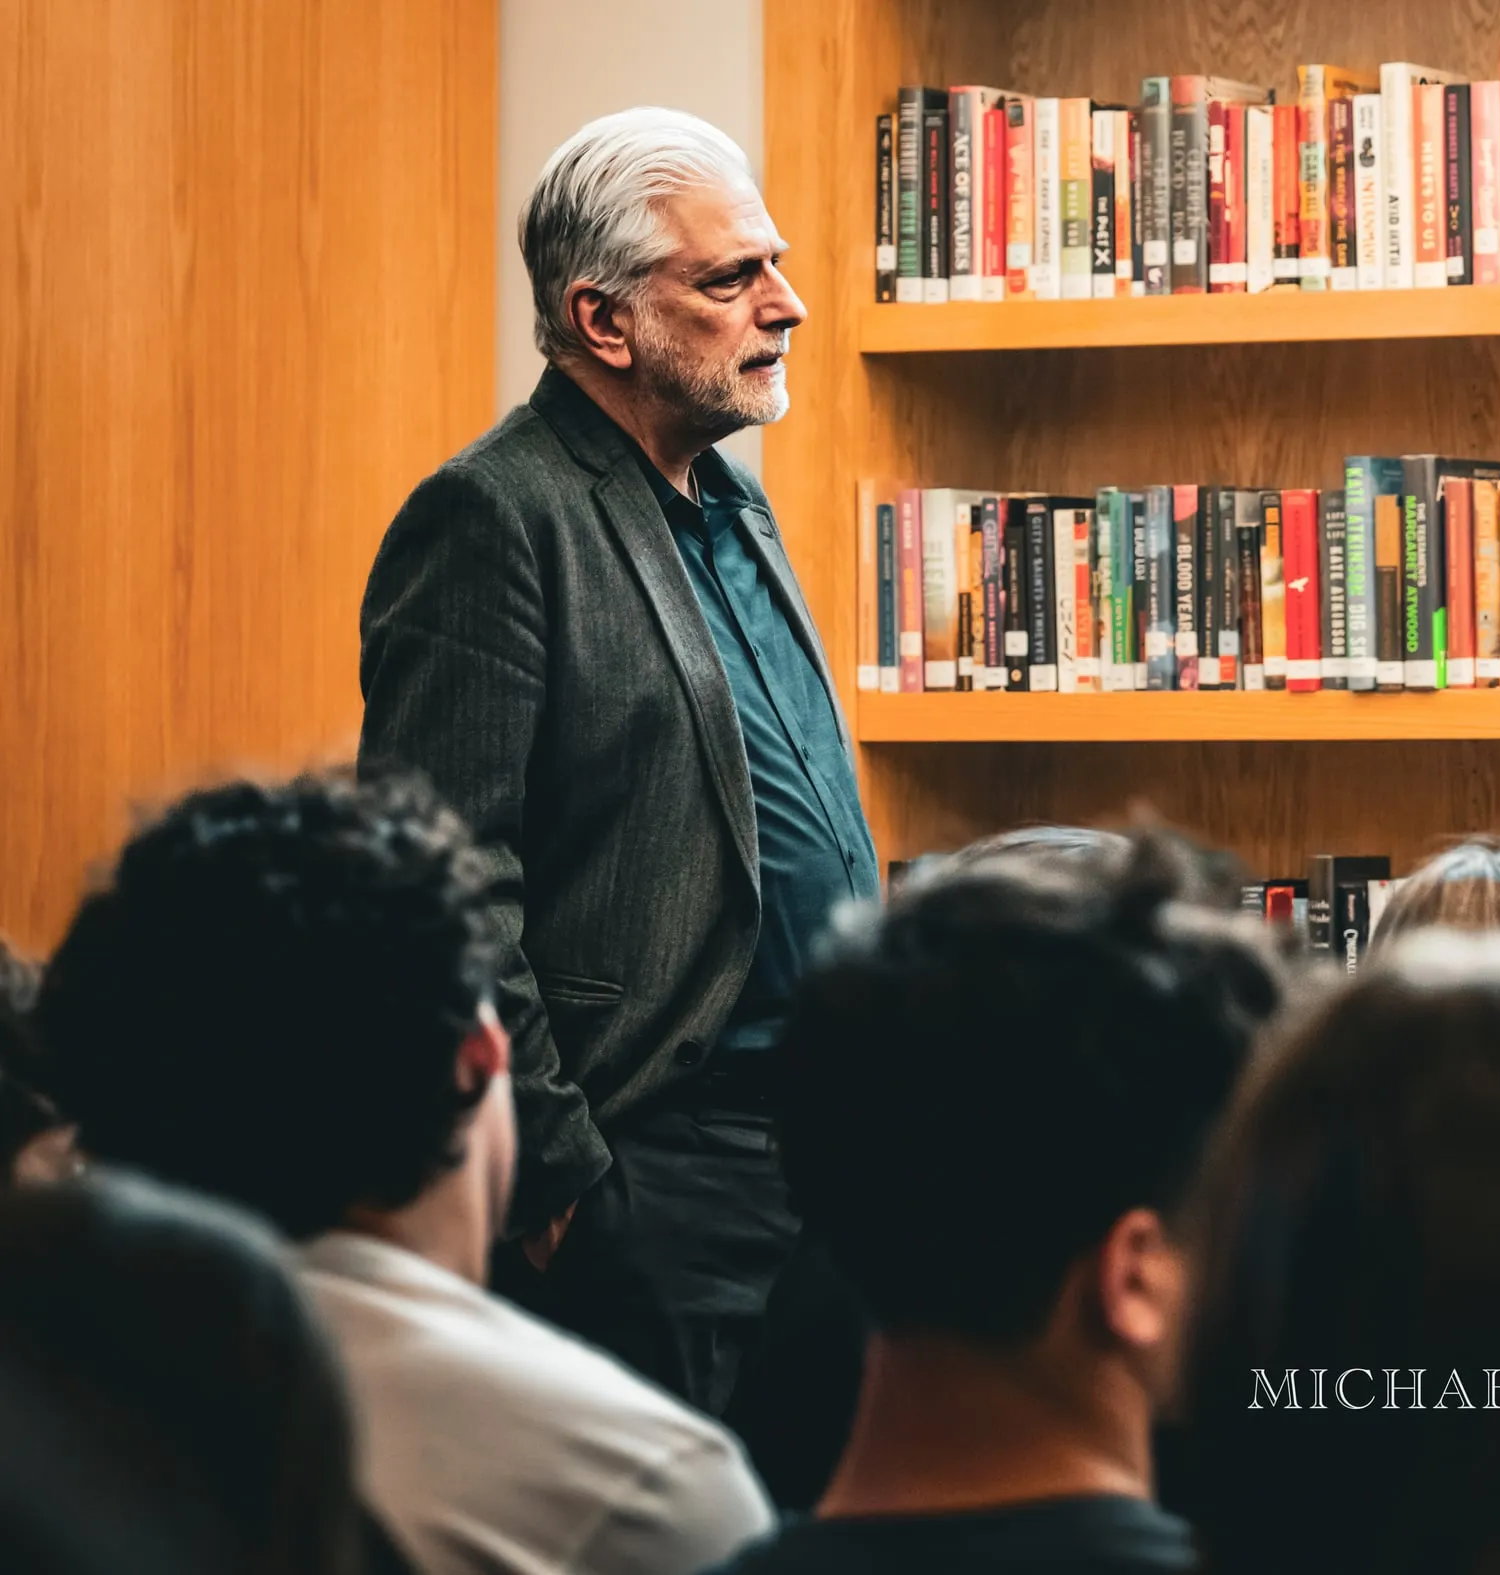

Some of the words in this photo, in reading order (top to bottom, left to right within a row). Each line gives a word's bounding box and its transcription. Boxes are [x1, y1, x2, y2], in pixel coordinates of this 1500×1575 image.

[953, 131, 970, 169] ACE
[954, 171, 971, 196] OF
[953, 200, 970, 271] SPADES
[1346, 467, 1365, 505] KATE
[1032, 516, 1043, 543] CITY
[1417, 503, 1426, 522] THE
[1347, 515, 1365, 597] ATKINSON
[1405, 495, 1418, 581] MARGARET
[1417, 524, 1427, 588] TESTAMENTS
[1032, 558, 1044, 601] SAINTS
[1177, 544, 1193, 590] BLOOD
[1330, 546, 1345, 580] KATE
[1177, 594, 1193, 632] YEAR
[1331, 586, 1345, 655] ATKINSON
[1406, 586, 1418, 653] ATWOOD
[1033, 612, 1045, 663] THIEVES
